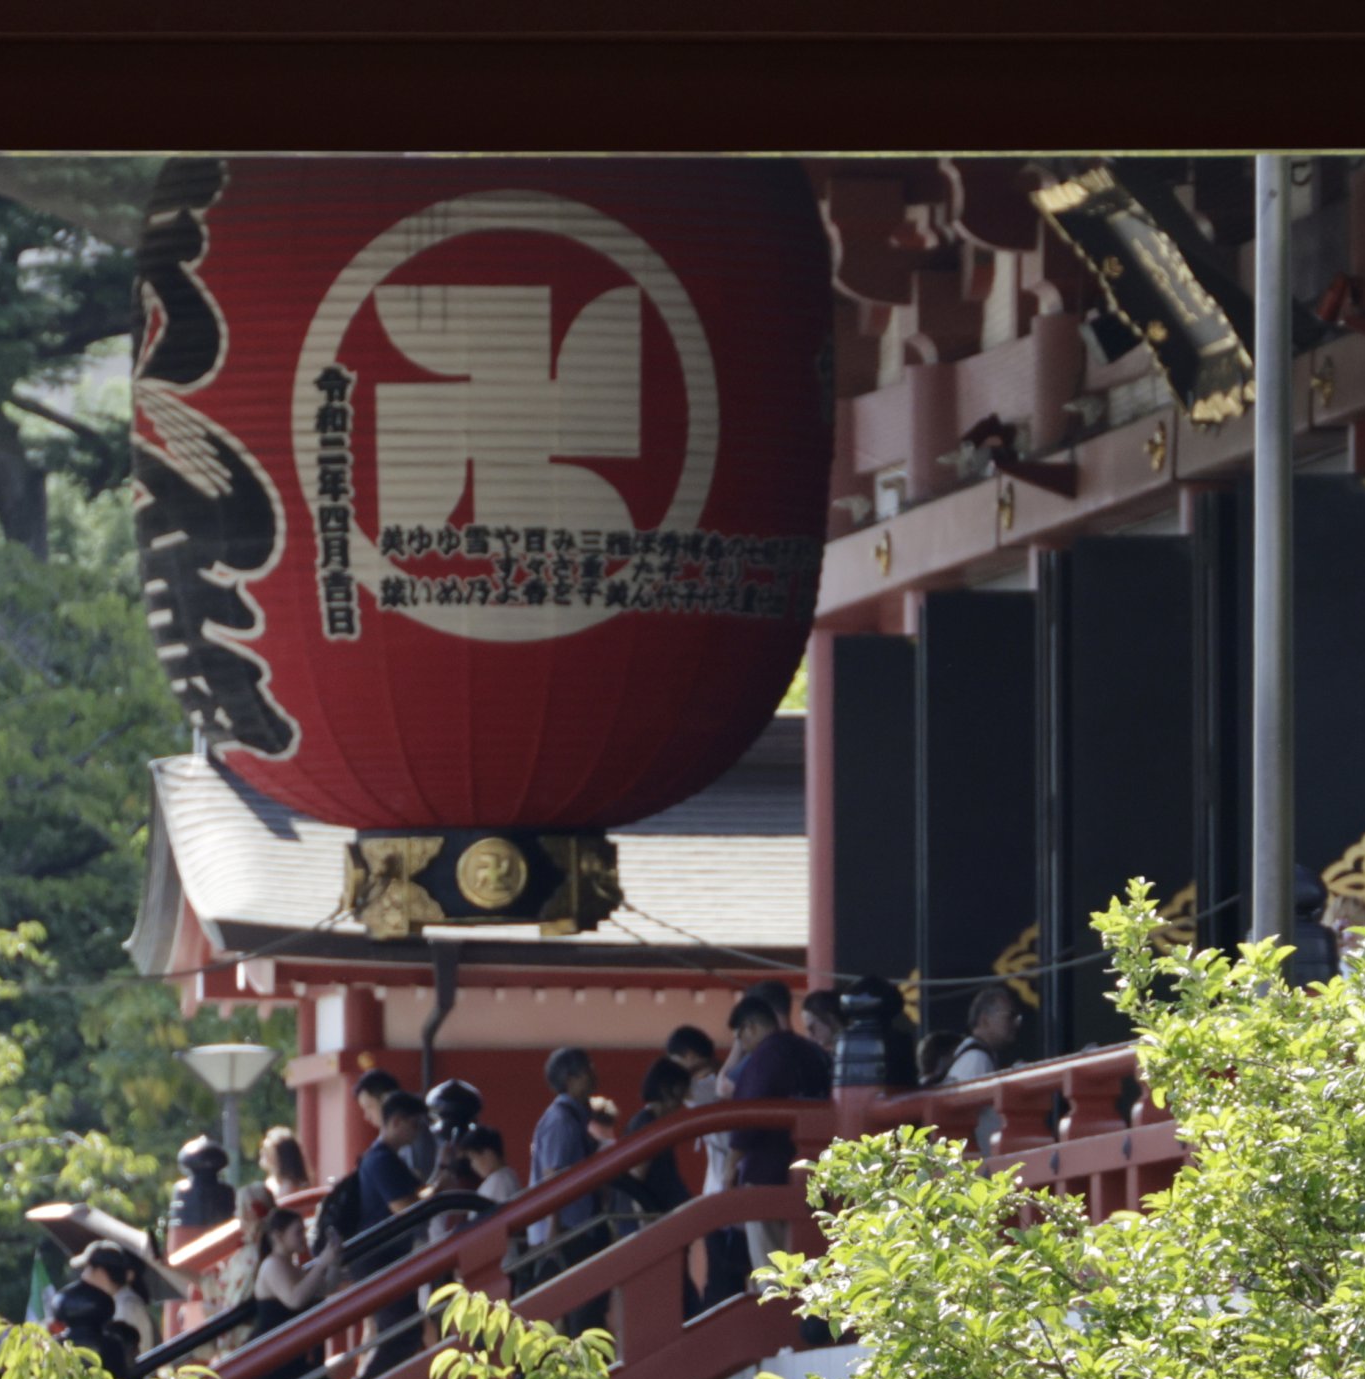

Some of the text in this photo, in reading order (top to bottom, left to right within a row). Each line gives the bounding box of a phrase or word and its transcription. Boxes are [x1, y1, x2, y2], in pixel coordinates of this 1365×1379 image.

[313, 365, 355, 636] 令和二年四月吉日
